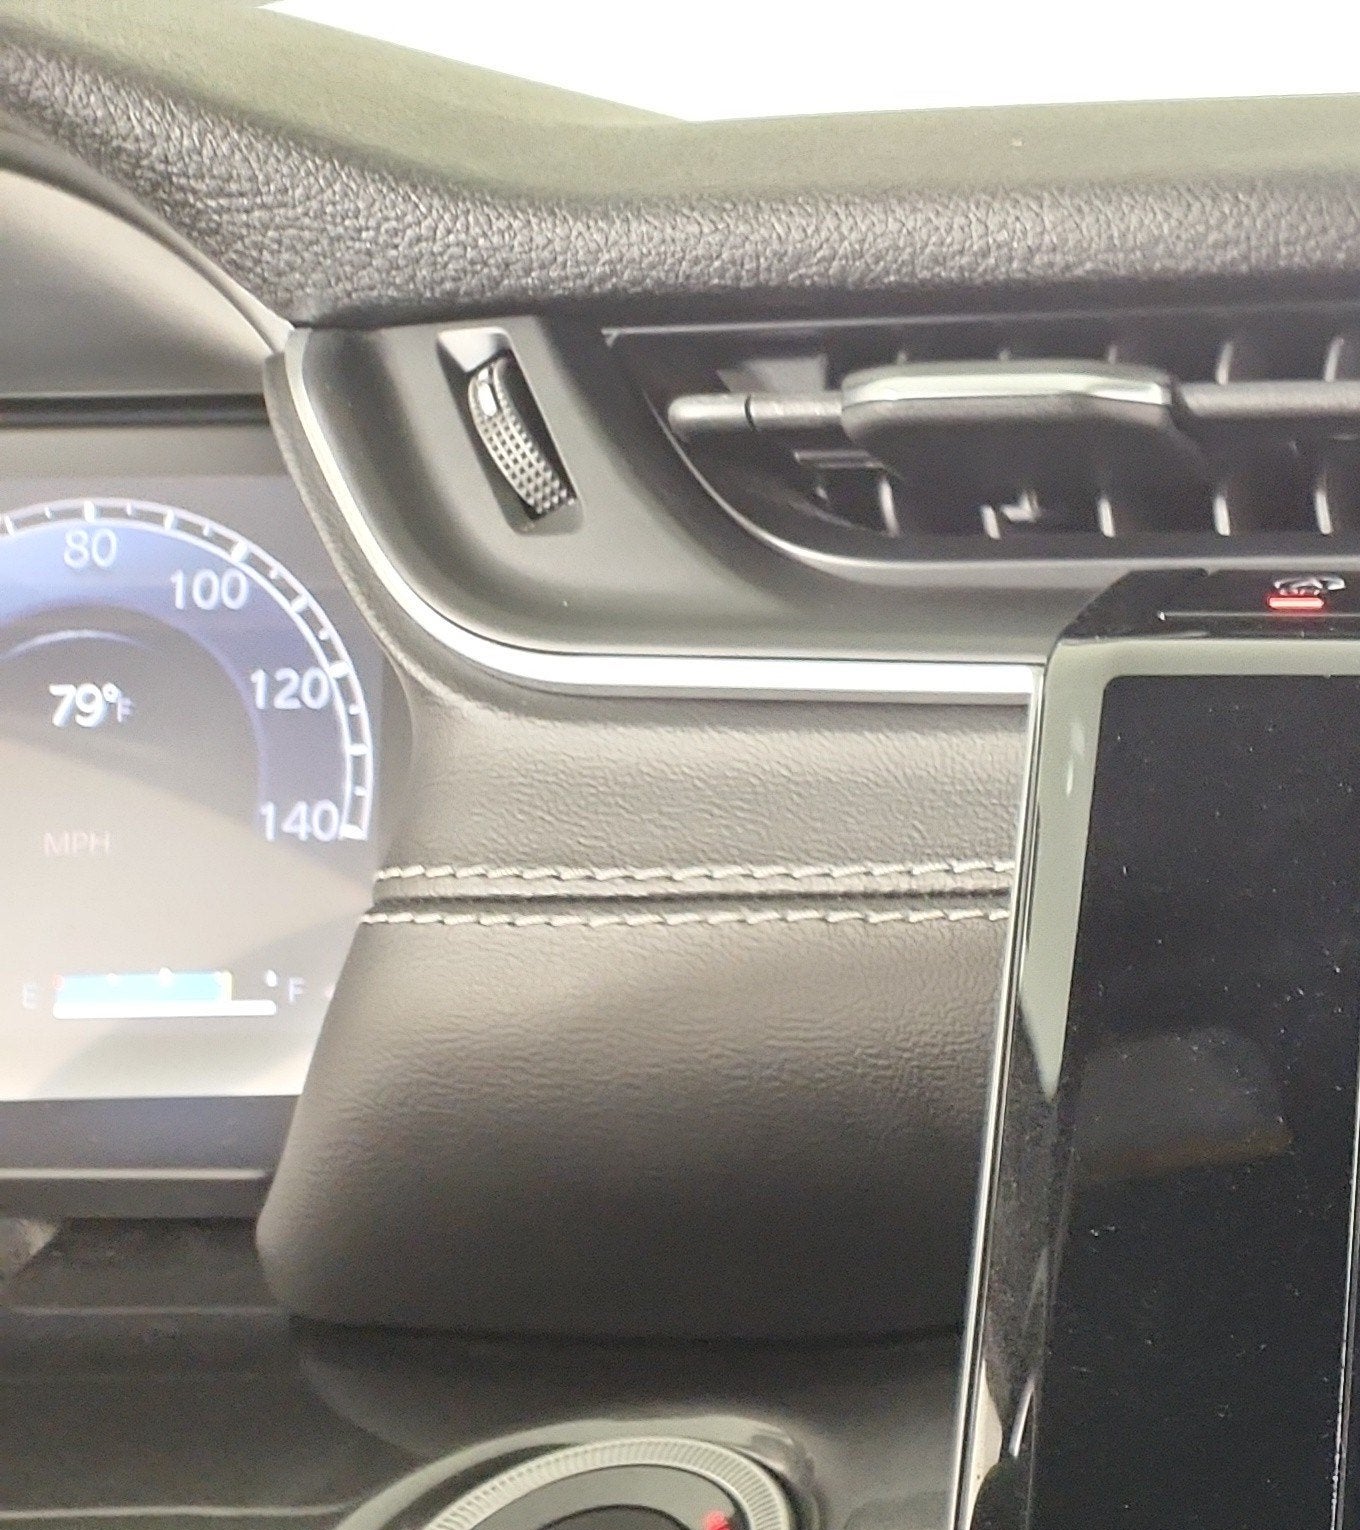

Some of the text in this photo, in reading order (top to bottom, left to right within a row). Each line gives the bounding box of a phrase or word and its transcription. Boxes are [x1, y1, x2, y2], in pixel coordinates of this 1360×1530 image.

[62, 528, 118, 570] 80
[168, 568, 250, 612] 100
[250, 667, 330, 711] 120
[258, 799, 341, 842] 140
[42, 830, 112, 858] MPH
